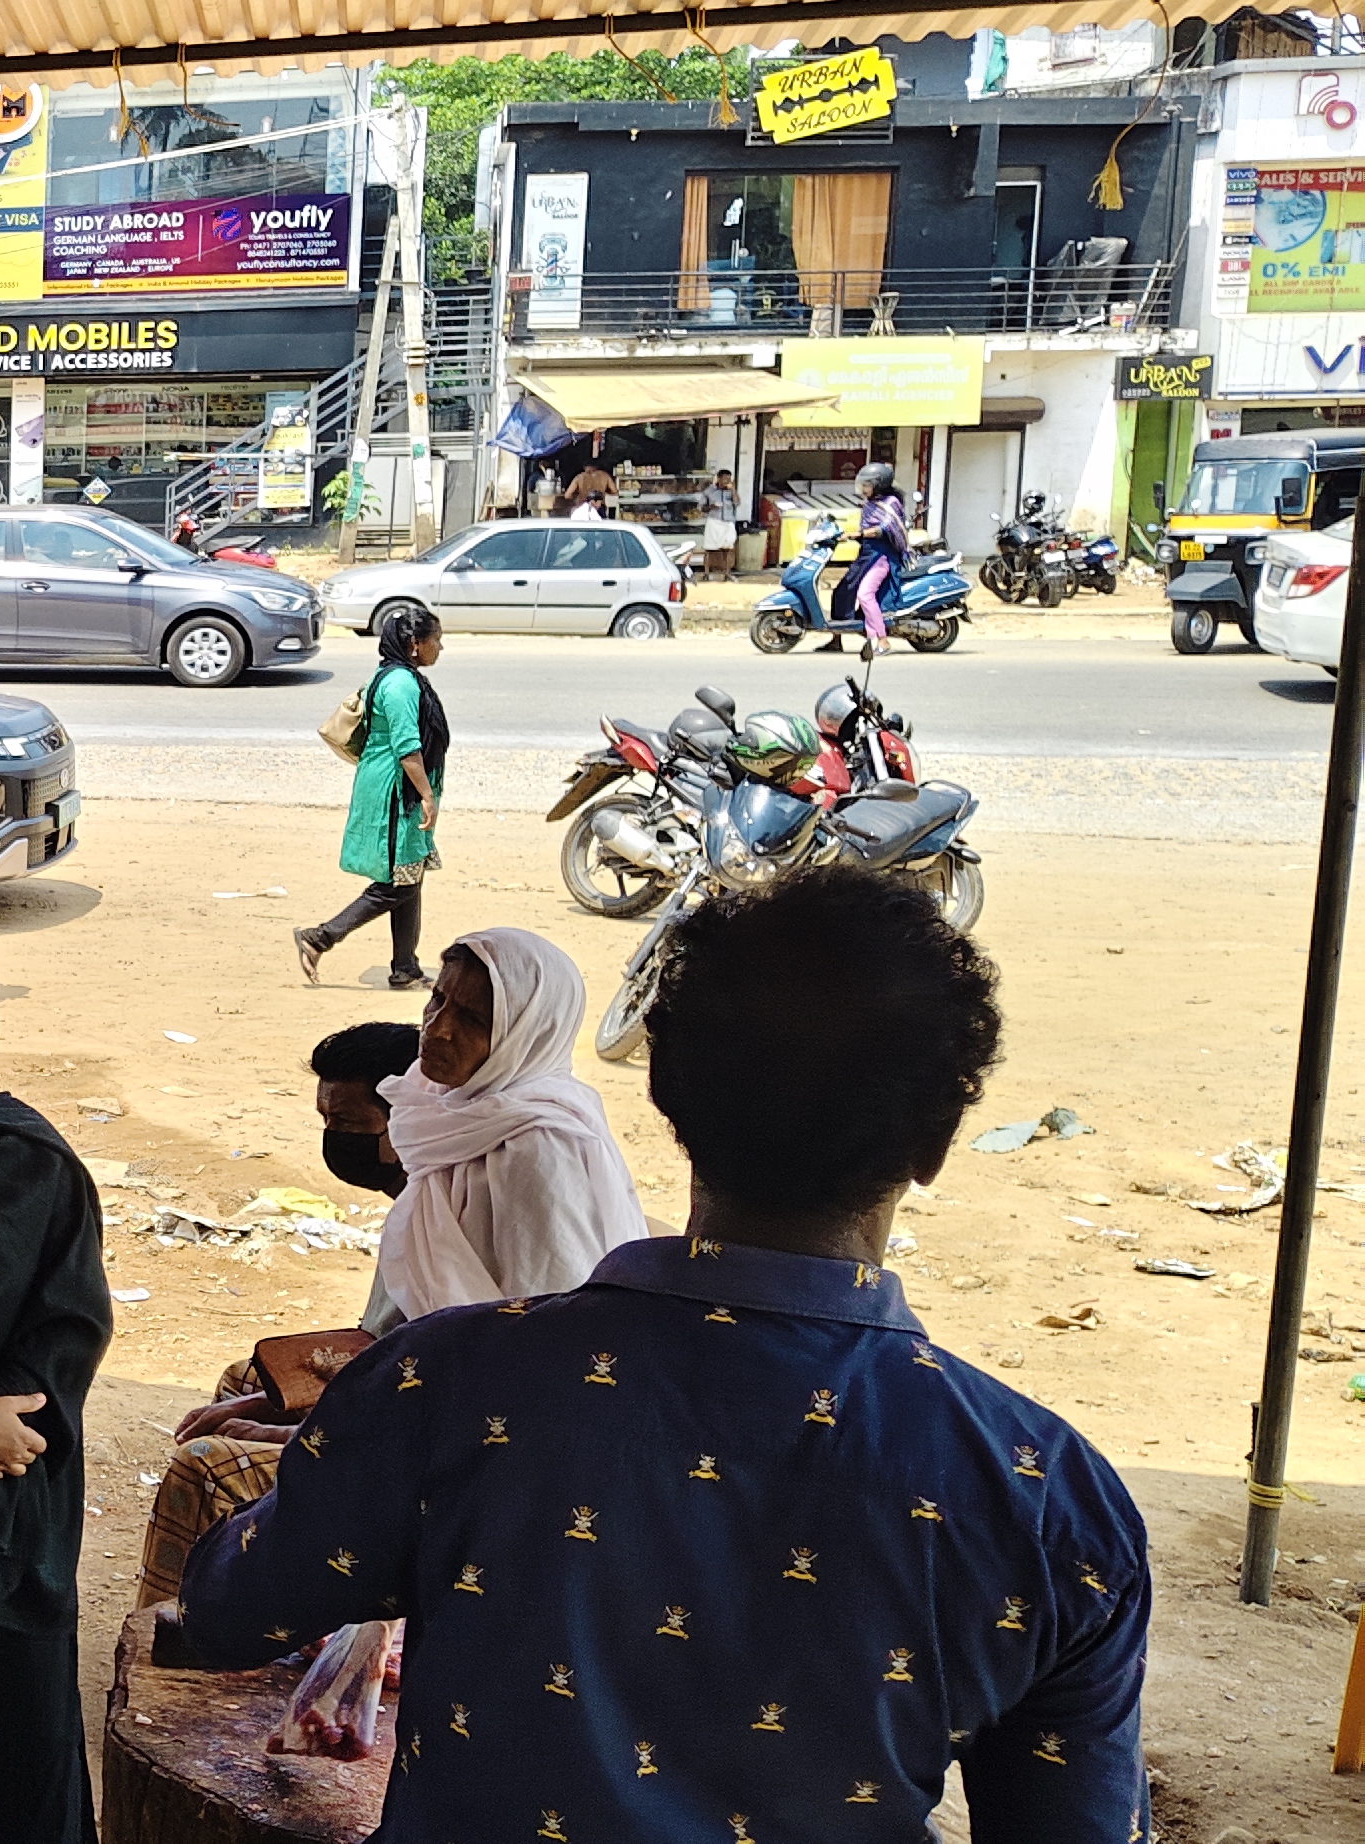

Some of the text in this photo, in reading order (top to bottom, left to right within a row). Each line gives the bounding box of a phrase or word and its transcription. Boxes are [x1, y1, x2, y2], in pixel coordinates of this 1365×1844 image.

[778, 56, 865, 93] URBAN
[787, 98, 874, 134] SALOON
[1228, 170, 1256, 179] vivo
[1257, 172, 1296, 184] ALES
[1300, 173, 1313, 184] &
[5, 213, 39, 226] VISA
[53, 211, 184, 232] STUDY ABROAD
[251, 204, 333, 234] youfly
[53, 230, 184, 245] GERMAN LANGUAGE IELTS
[53, 245, 107, 256] COACHING
[60, 261, 92, 269] GERMANY
[237, 258, 340, 270] youflyconsultancy.com
[1262, 261, 1346, 278] 0% EMI
[27, 320, 178, 351] MOBILES
[51, 351, 172, 370] ACCESSORIES
[1303, 336, 1365, 374] V
[1130, 358, 1200, 391] URBAN
[1161, 388, 1200, 397] SALOON
